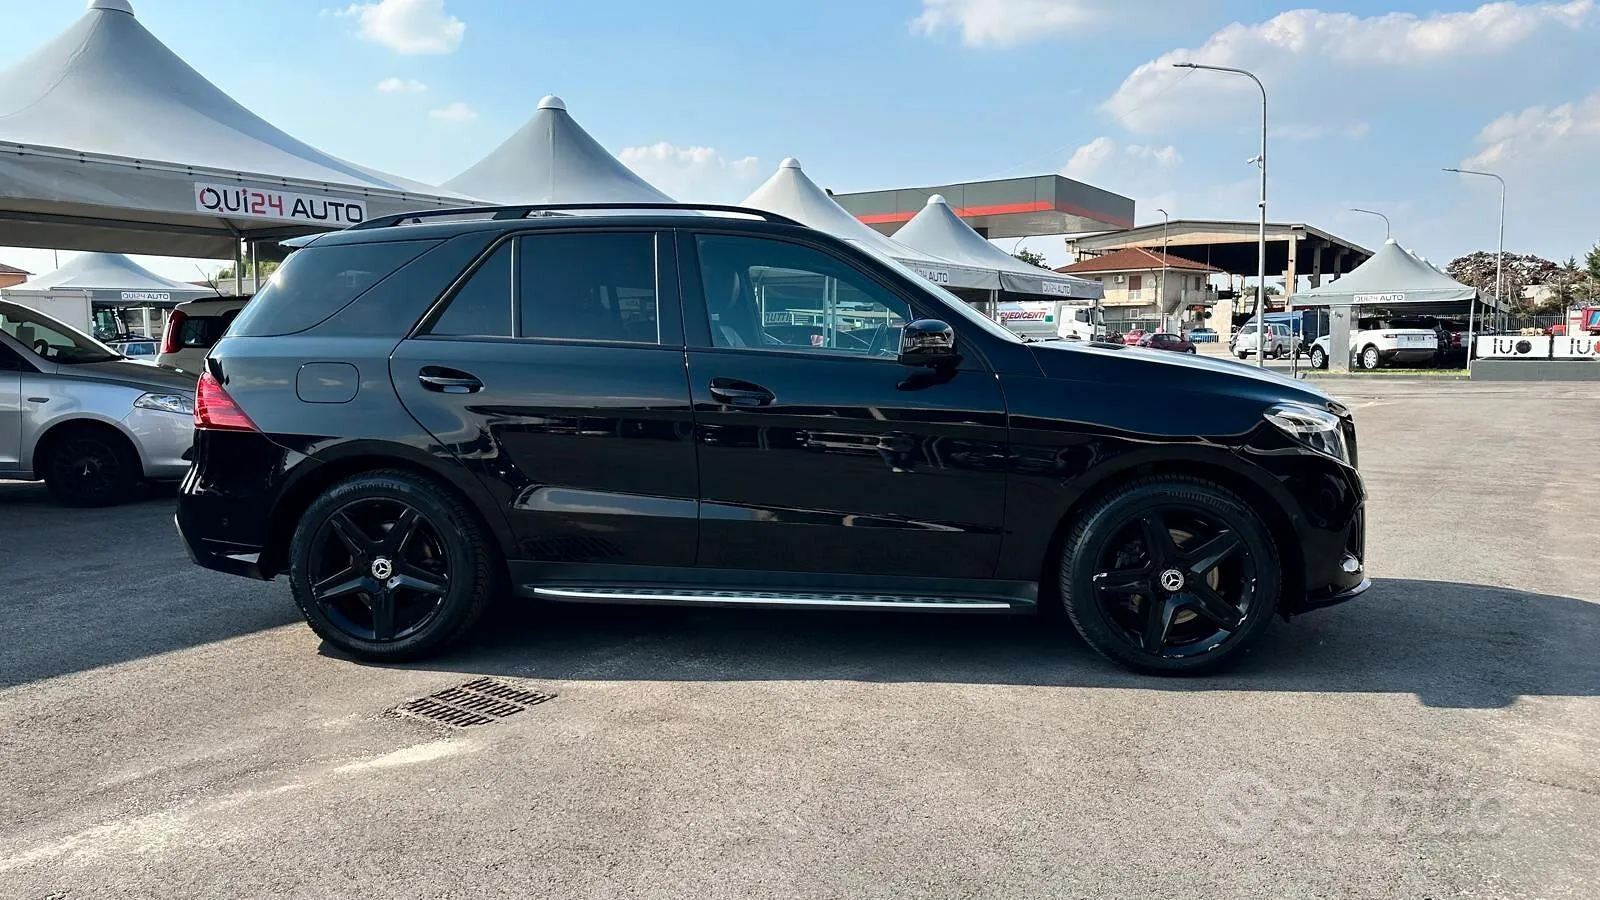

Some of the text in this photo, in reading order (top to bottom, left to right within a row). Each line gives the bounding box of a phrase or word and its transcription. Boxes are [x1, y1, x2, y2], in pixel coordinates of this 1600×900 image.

[290, 198, 363, 223] AUTO
[928, 271, 948, 282] AUTO
[1380, 294, 1404, 302] AUTO
